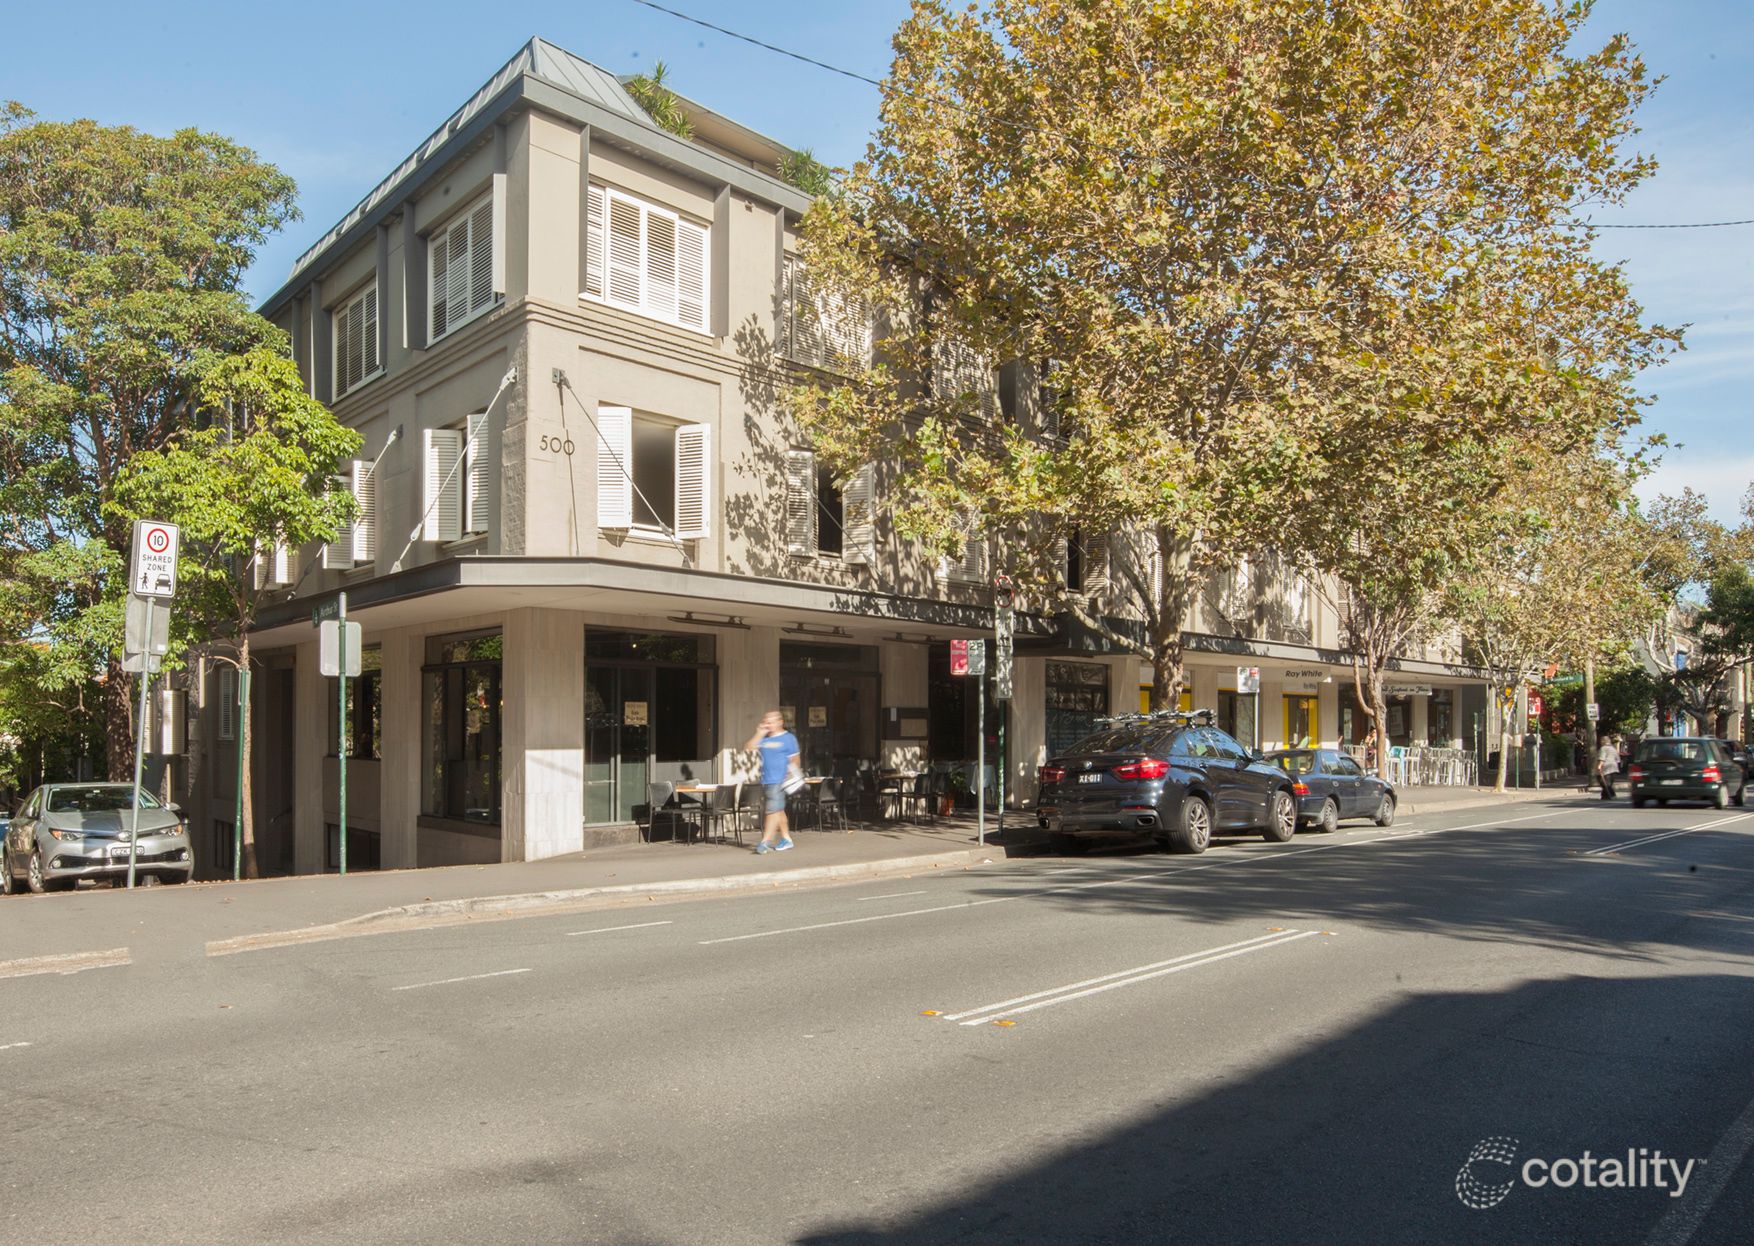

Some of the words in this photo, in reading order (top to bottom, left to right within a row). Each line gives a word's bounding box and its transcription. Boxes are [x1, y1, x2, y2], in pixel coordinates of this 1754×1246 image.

[539, 434, 575, 456] 500
[153, 535, 164, 547] 10
[142, 554, 173, 564] SHARED
[147, 563, 167, 572] ZONE
[969, 642, 983, 651] 2P
[1285, 670, 1300, 678] Ray
[1301, 669, 1323, 678] White
